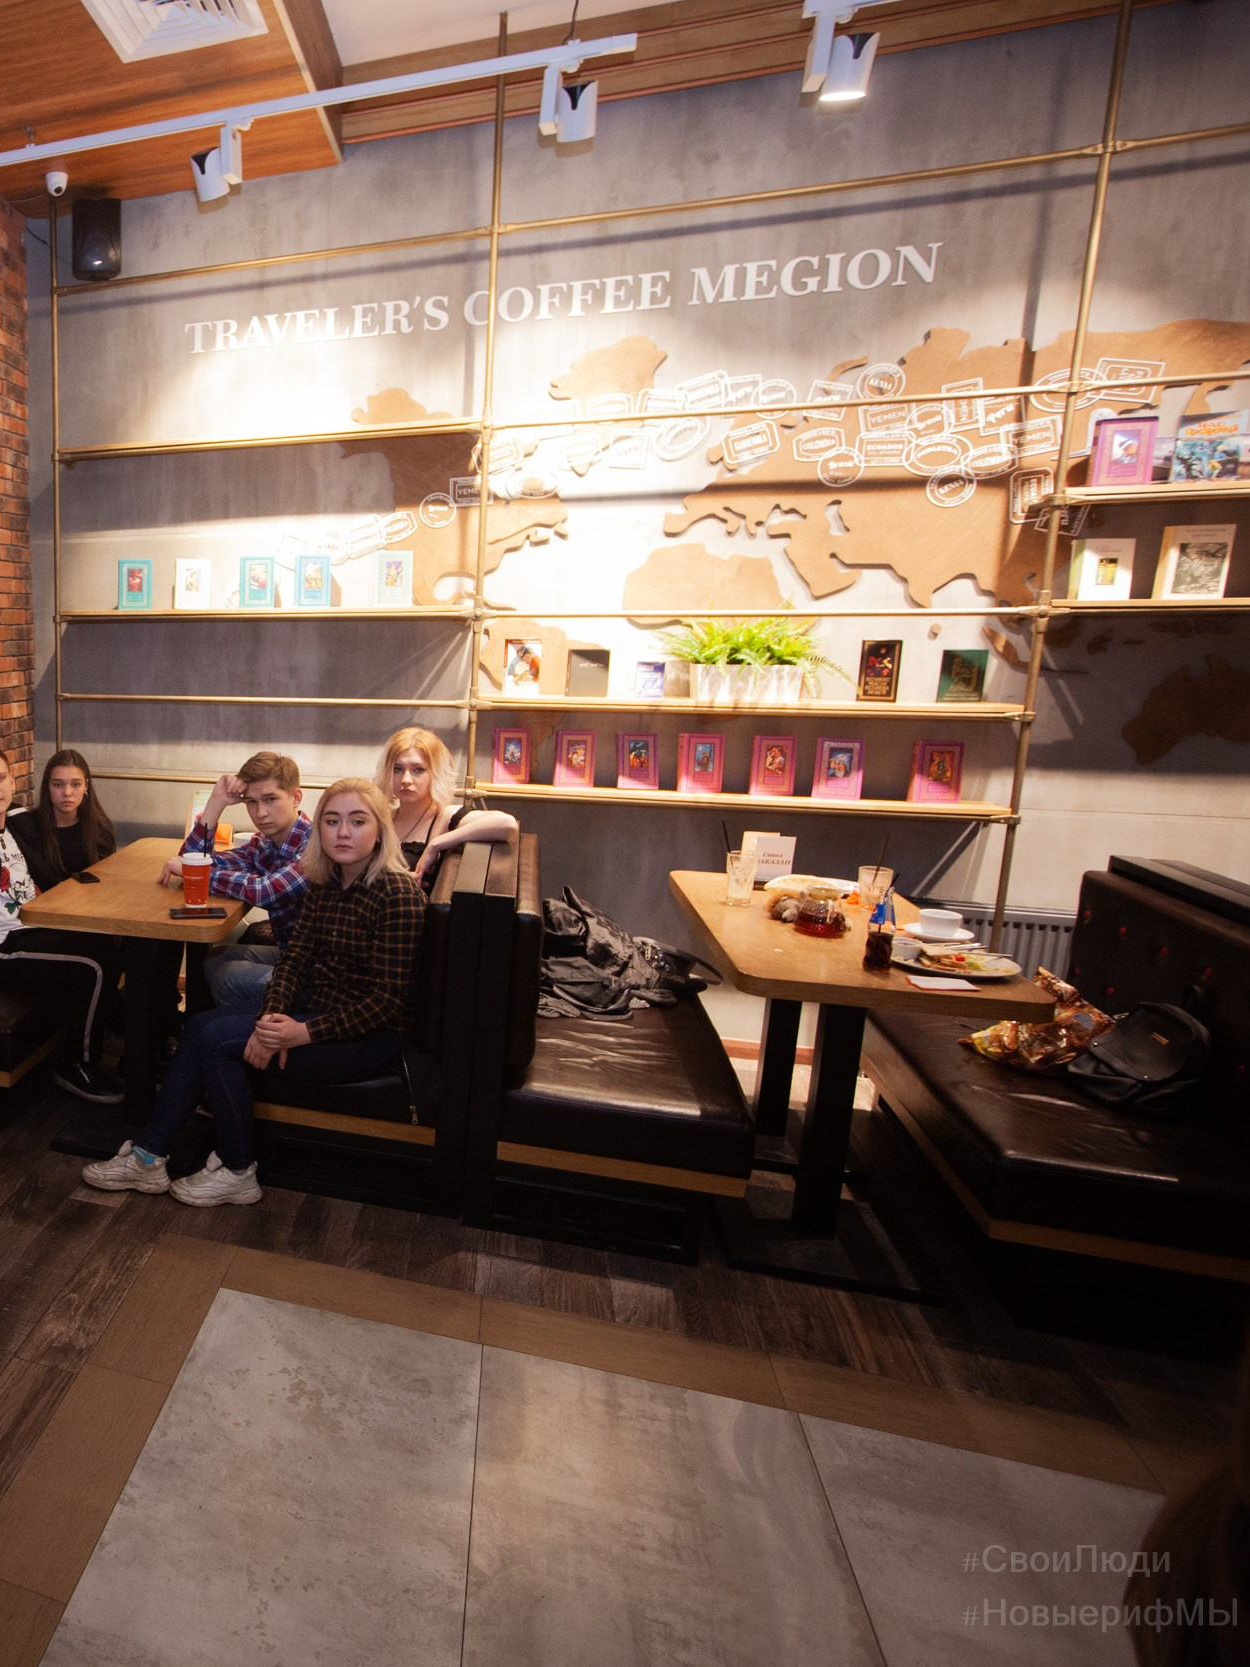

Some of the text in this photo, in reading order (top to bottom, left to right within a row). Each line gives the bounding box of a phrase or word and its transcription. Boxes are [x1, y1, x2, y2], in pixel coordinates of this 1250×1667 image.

[184, 242, 944, 354] TRAVELER'S COFFEE MEGION
[870, 410, 906, 424] YEMEN
[1012, 431, 1052, 444] YEMEN
[457, 487, 479, 495] YEME
